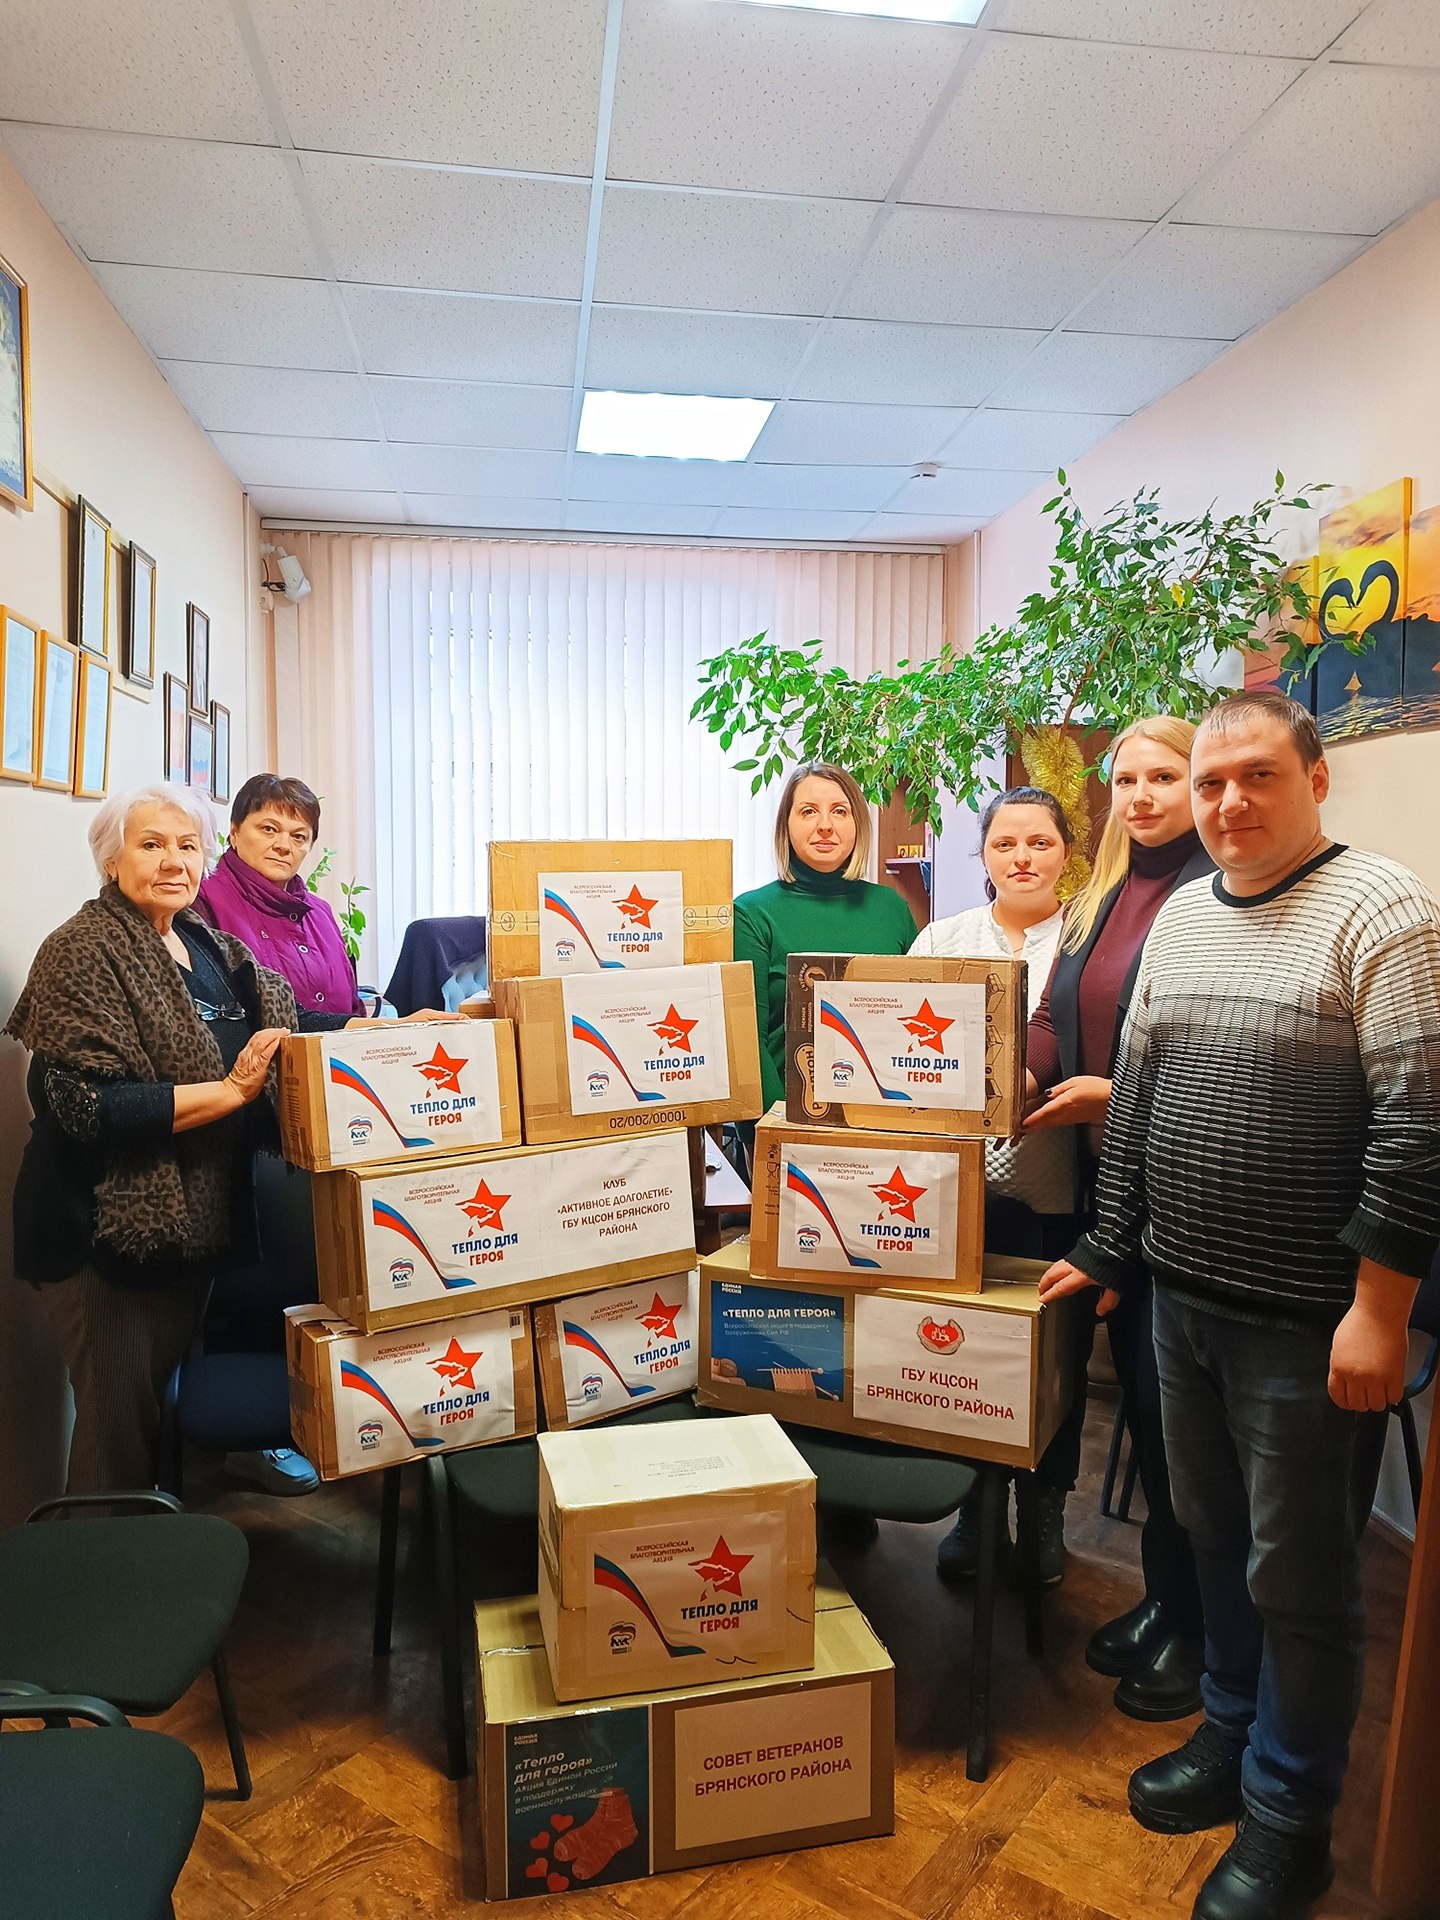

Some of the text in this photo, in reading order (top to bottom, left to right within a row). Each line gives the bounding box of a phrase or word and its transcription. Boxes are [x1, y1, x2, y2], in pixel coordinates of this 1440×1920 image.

[607, 932, 663, 942] ТЕПЛО ДЛЯ
[621, 944, 650, 953] ГЕРОЯ
[644, 1055, 705, 1071] ТЕПЛО ДЛЯ
[891, 1056, 959, 1071] ТЕПЛО ДЛЯ
[660, 1070, 692, 1083] ГЕРОЯ
[907, 1071, 942, 1083] ГЕРОЯ
[410, 1096, 476, 1115] ТЕПЛО ДЛЯ
[428, 1112, 462, 1127] ГЕРОЯ
[609, 1110, 687, 1129] 10000/200/20
[603, 1177, 627, 1191] КЛУБ
[562, 1201, 670, 1229] ГБУ КЦСОН БРЯНСКОГО
[599, 1222, 638, 1237] РАЙОНА
[860, 1224, 930, 1240] ТЕПЛО ДЛЯ
[452, 1233, 519, 1255] ТЕПЛО ДЛЯ
[876, 1239, 913, 1252] ГЕРОЯ
[469, 1250, 504, 1266] ГЕРОЯ
[722, 1308, 836, 1319] «ТЕПЛО ДЛЯ ГЕРОЯ»
[634, 1340, 691, 1365] ТЕПЛО ДЛЯ
[650, 1357, 679, 1374] ГЕРОЯ
[901, 1367, 979, 1391] ГБУ КЦСОН
[423, 1391, 490, 1415] ТЕПЛО ДЛЯ
[867, 1384, 1015, 1420] БРЯНСКОГО РАЙОНА
[440, 1408, 474, 1426] ГЕРОЯ
[636, 1540, 689, 1552] ВСЕРОССИЙСКАЯ
[680, 1599, 759, 1621] ТЕПЛО ДЛЯ
[700, 1617, 740, 1634] ГЕРОЯ
[515, 1752, 565, 1771] «Тепло
[703, 1735, 844, 1771] СОВЕТ ВЕТЕРАНОВ
[513, 1757, 593, 1785] для героя»
[515, 1762, 618, 1794] Акция Единой России
[695, 1758, 852, 1797] БРЯНСКОГО РАЙОНА
[515, 1787, 598, 1815] военнослужащих
[522, 1783, 576, 1802] поддержку
